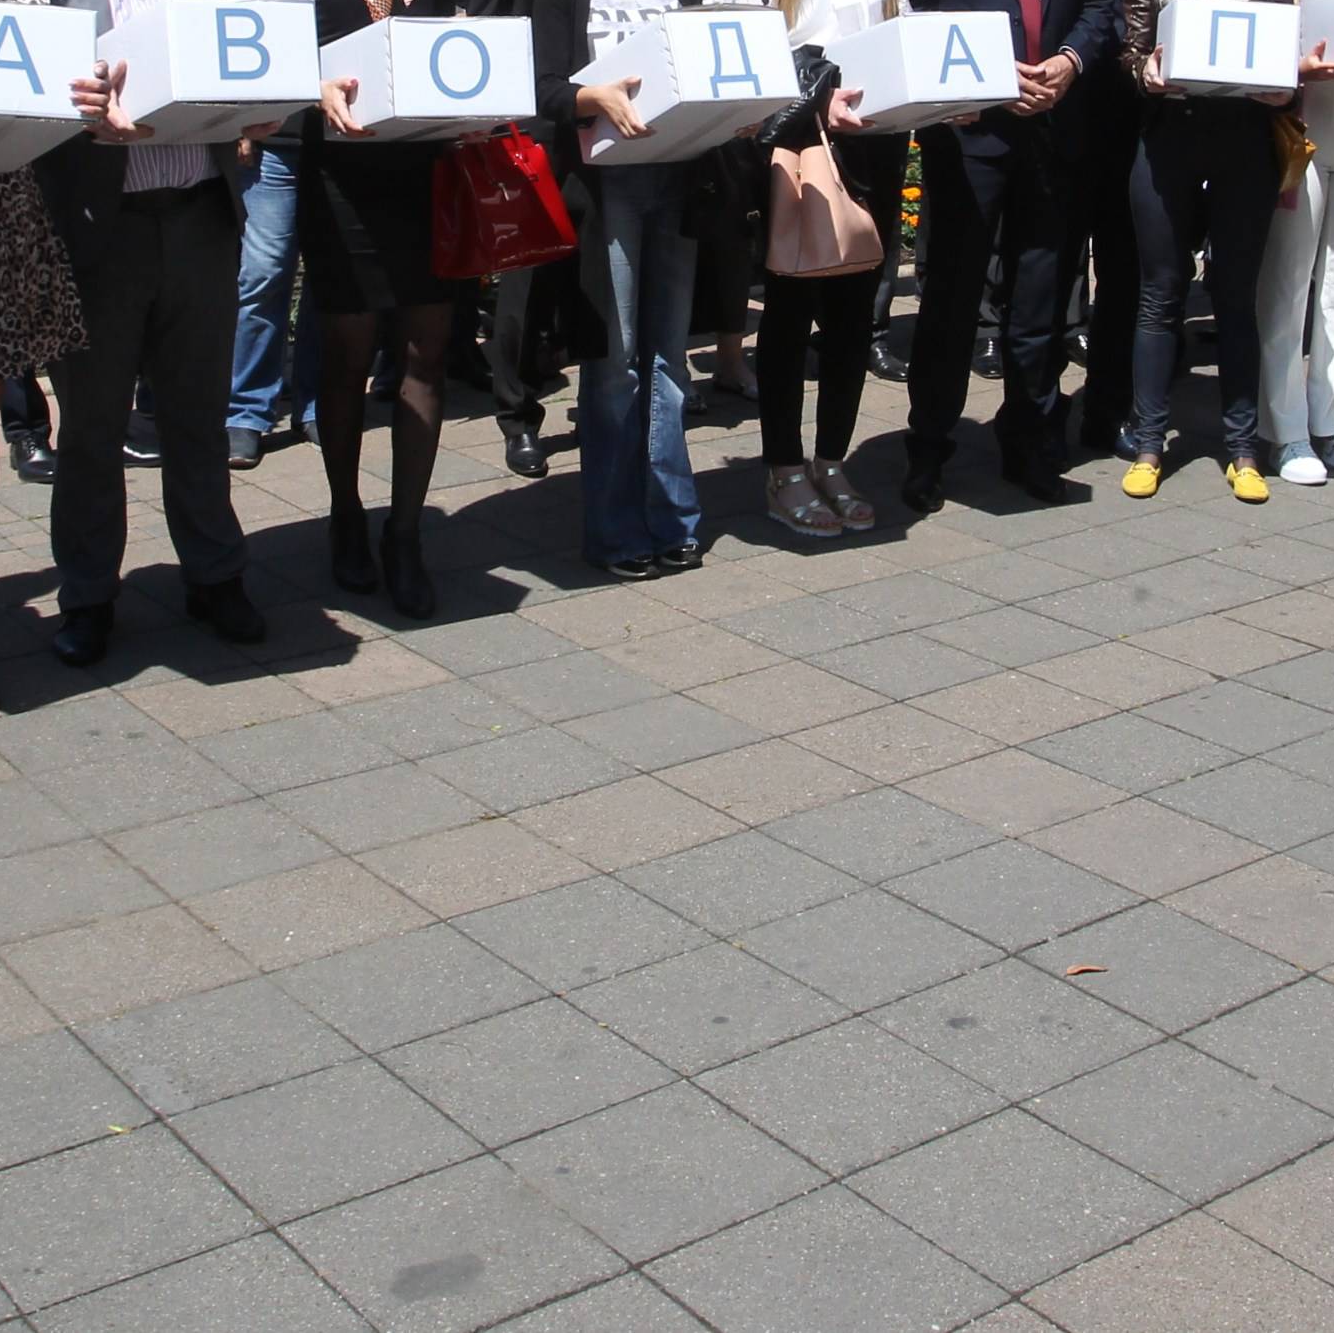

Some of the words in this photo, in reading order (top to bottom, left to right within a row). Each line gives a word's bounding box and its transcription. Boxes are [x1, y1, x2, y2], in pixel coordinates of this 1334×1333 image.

[216, 8, 270, 81] В
[430, 29, 490, 100] О
[709, 21, 762, 99] Д
[940, 25, 984, 84] А
[1209, 10, 1256, 68] П
